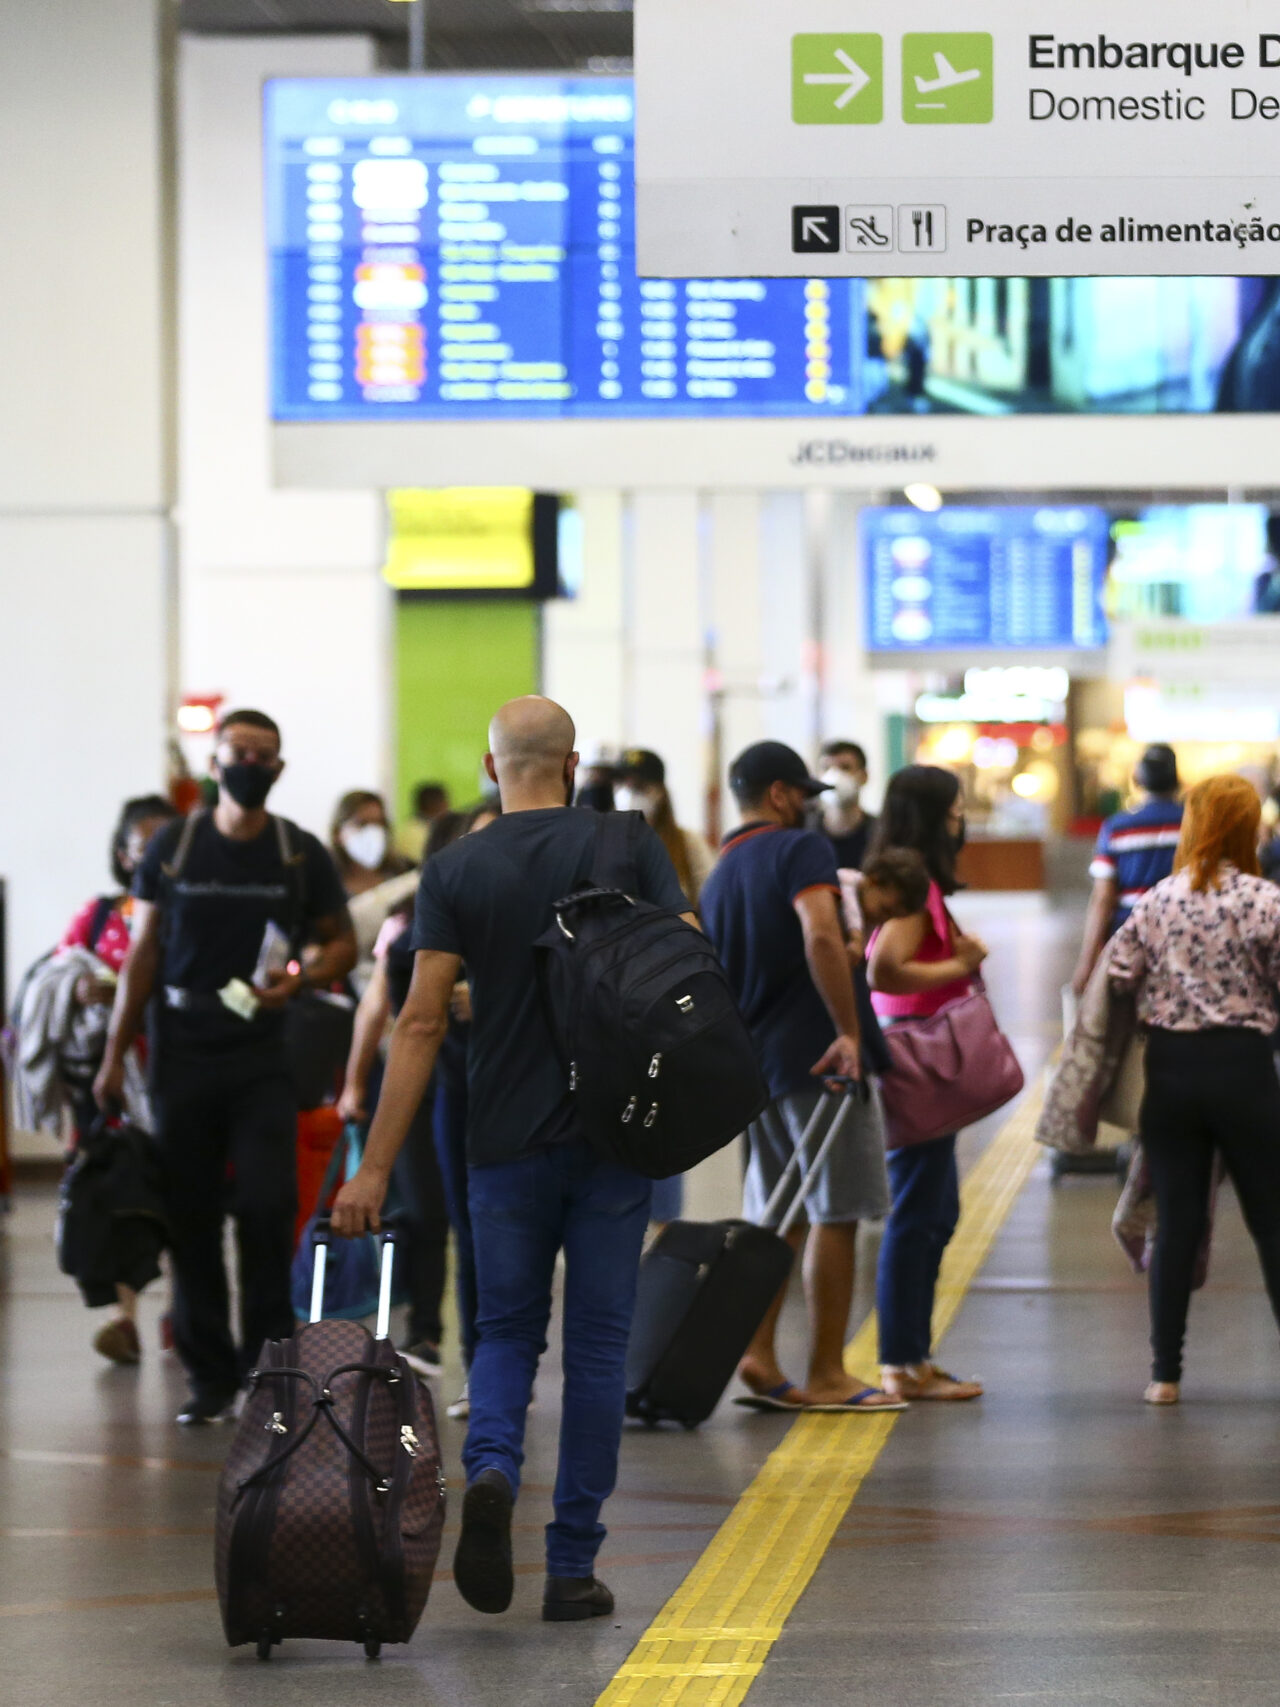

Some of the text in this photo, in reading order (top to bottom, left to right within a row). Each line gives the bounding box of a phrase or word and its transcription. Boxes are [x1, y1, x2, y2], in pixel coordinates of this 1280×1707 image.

[1028, 34, 1245, 76] Embarque
[1028, 88, 1205, 121] Domestic
[966, 218, 1047, 249] Praça
[1055, 217, 1092, 242] de
